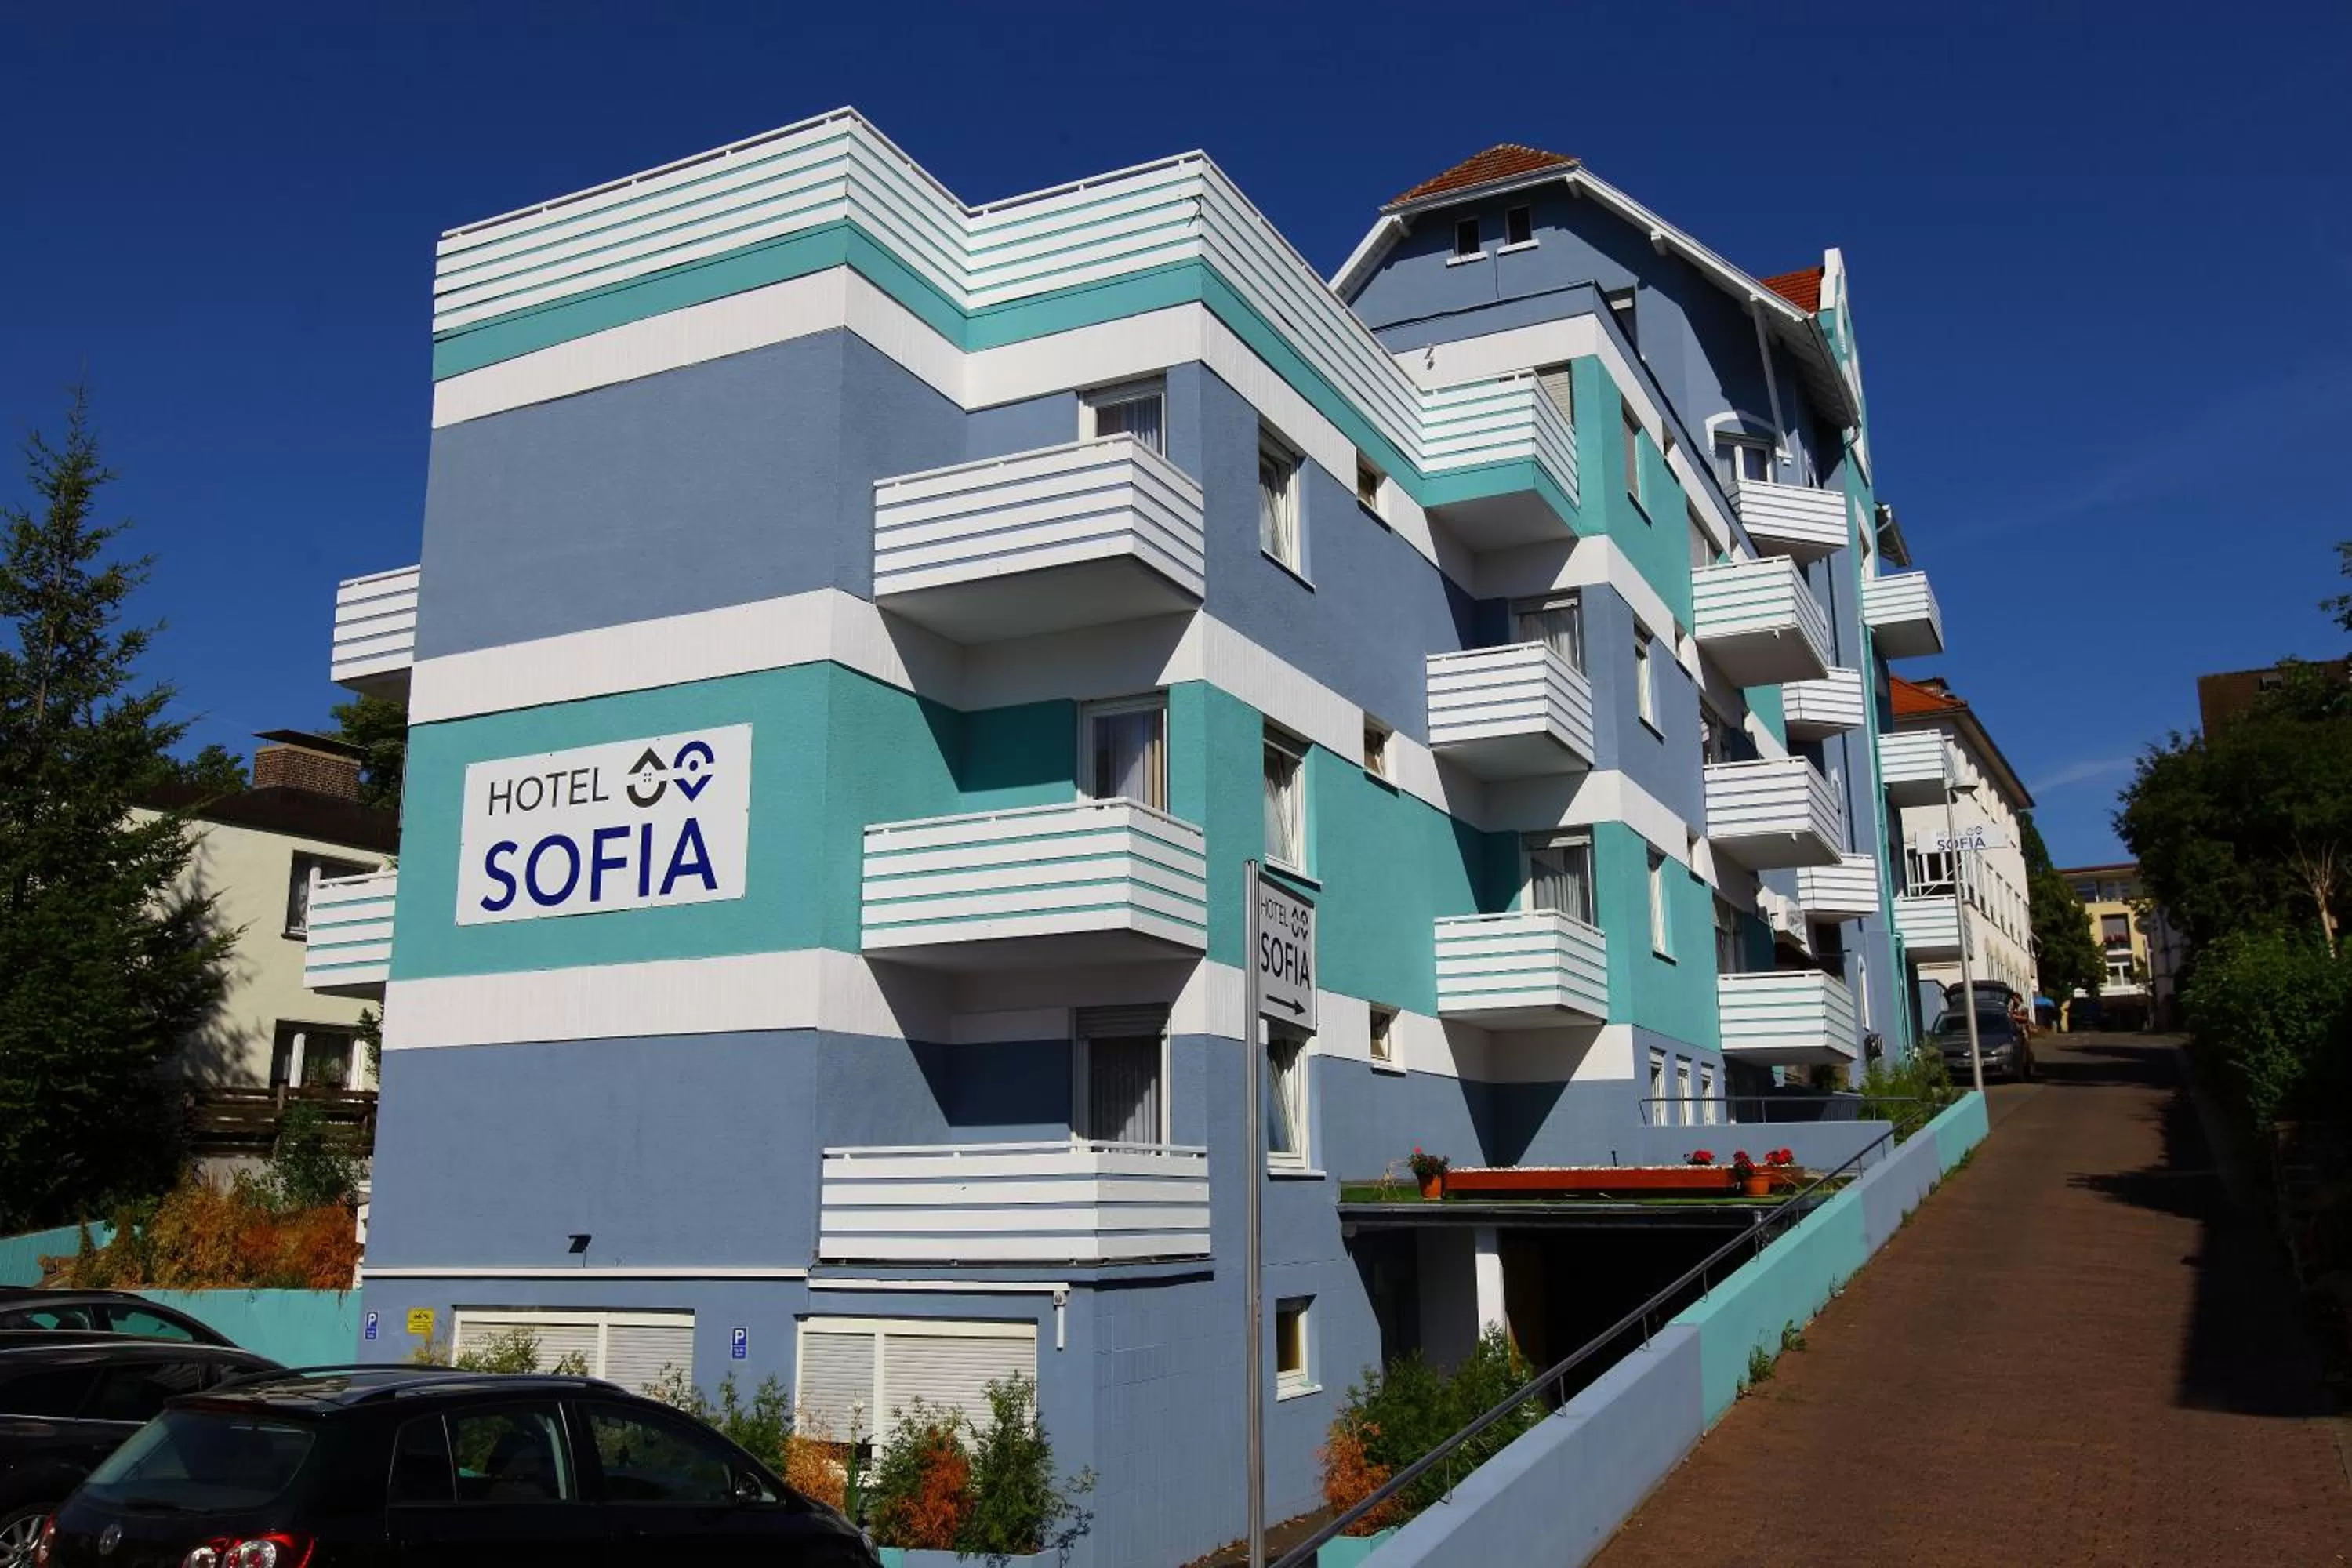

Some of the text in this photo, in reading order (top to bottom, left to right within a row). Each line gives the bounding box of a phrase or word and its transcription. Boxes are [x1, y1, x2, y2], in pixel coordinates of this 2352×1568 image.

[488, 767, 609, 816] HOTEL
[1937, 837, 1986, 851] SOFIA
[480, 817, 718, 912] SOFIA
[1260, 895, 1289, 927] HOTEL
[1261, 931, 1312, 991] SOFIA
[735, 1329, 745, 1344] P
